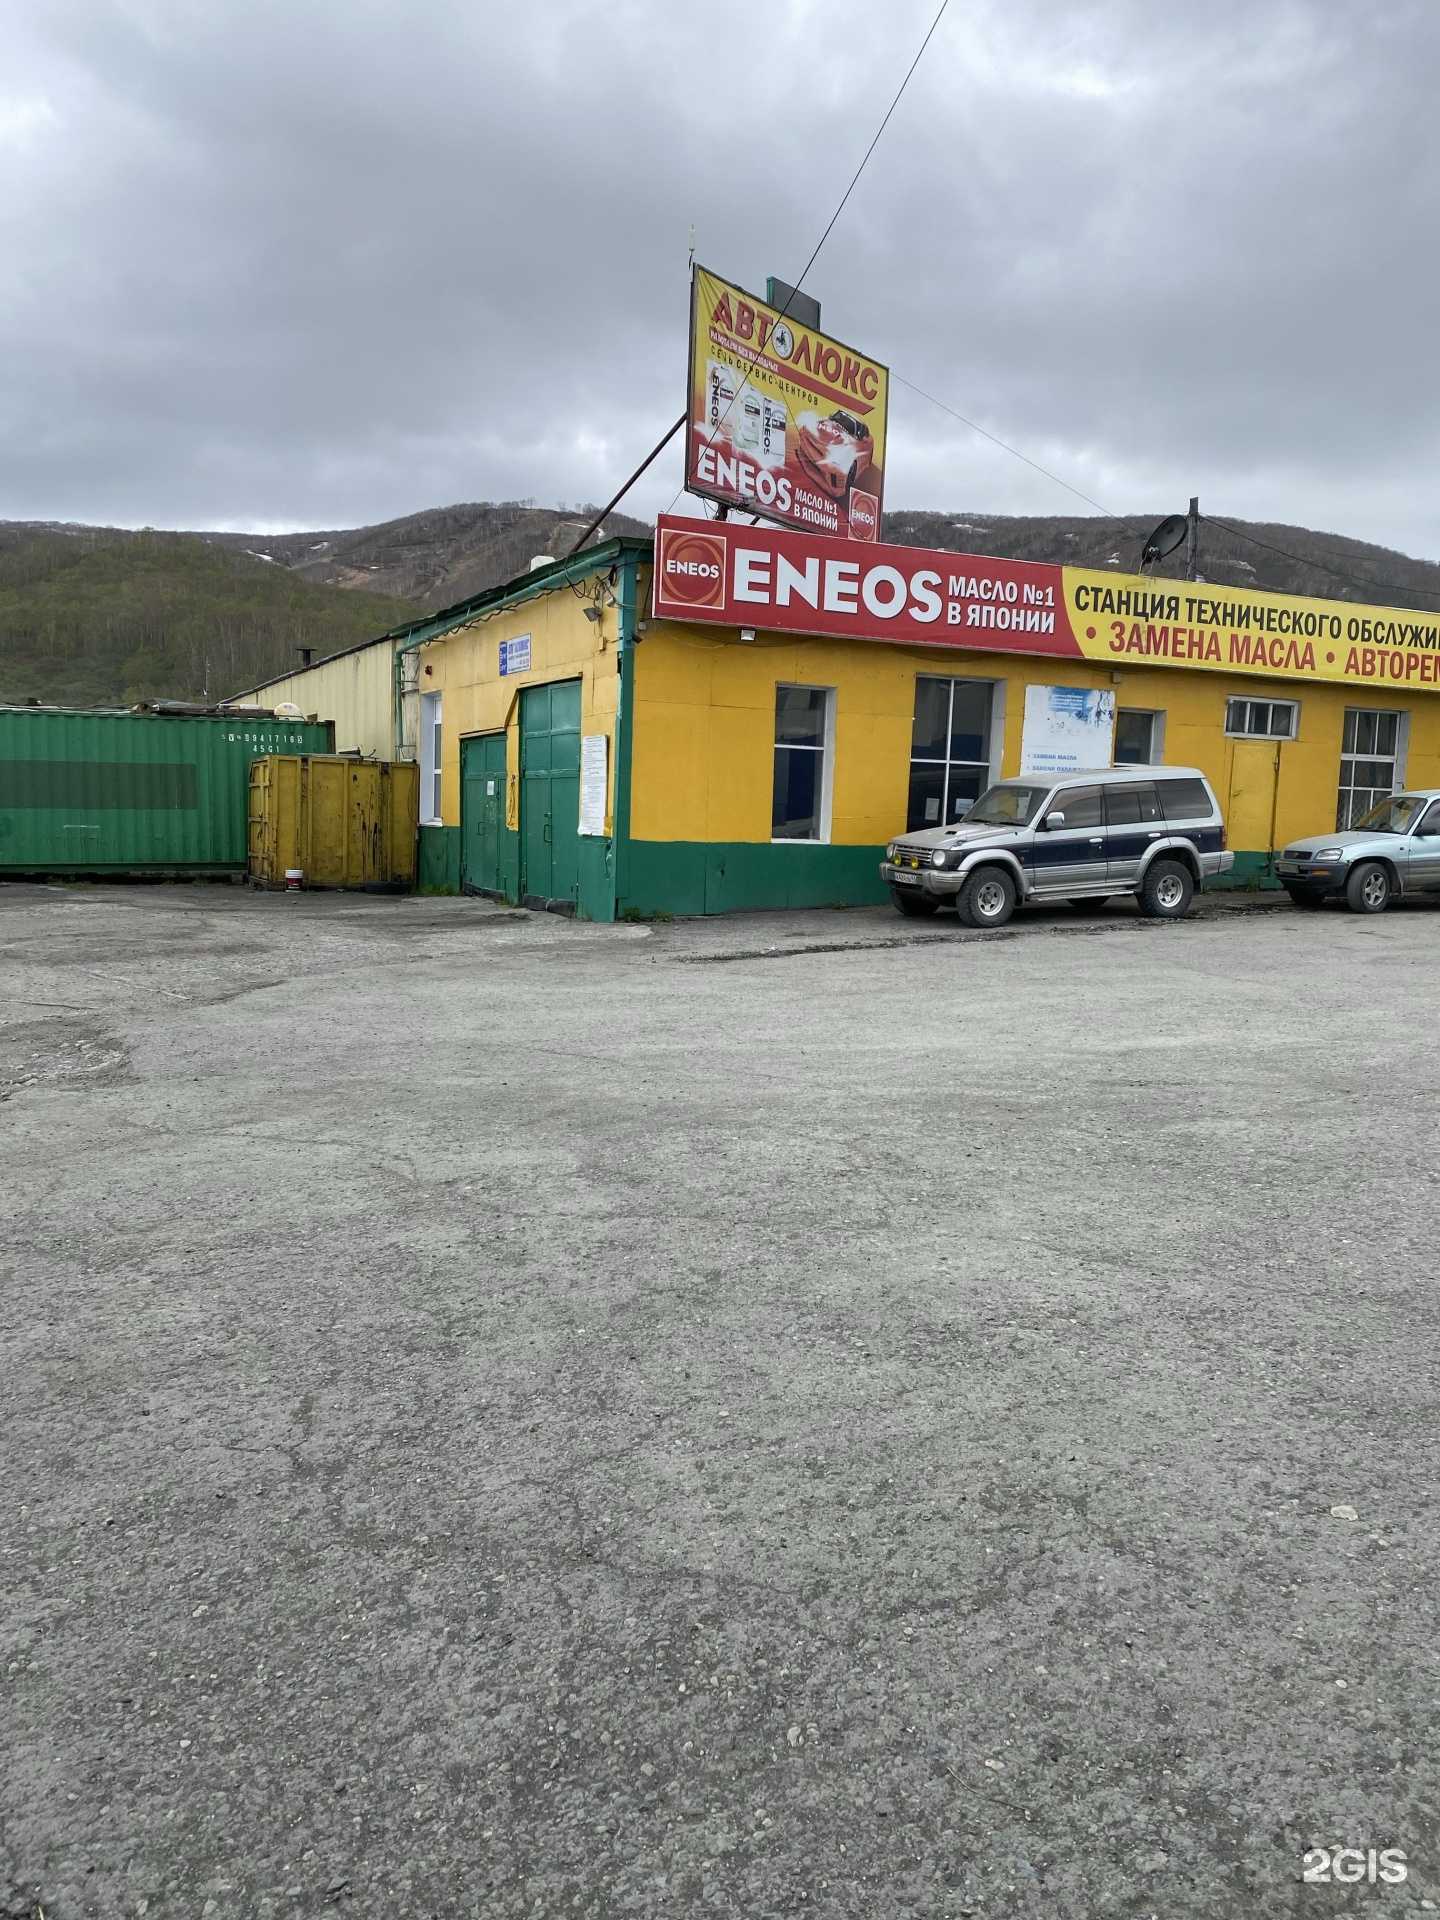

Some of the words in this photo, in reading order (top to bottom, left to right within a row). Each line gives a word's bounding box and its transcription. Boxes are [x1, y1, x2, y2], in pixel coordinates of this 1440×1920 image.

[764, 406, 772, 455] ENEOS
[697, 444, 792, 512] ENEOS
[795, 487, 824, 510] МАСЛО
[824, 500, 838, 515] №1
[851, 508, 875, 525] ENEOS
[794, 504, 801, 517] В
[802, 507, 838, 532] ЯПОНИИ
[666, 559, 720, 579] ENEOS
[733, 548, 943, 624] ENEOS
[948, 575, 1018, 607] МАСЛО
[1023, 585, 1055, 608] №1
[947, 603, 962, 625] В
[966, 605, 1055, 634] ЯПОНИИ
[1074, 584, 1180, 622] СТАНЦИЯ
[1185, 597, 1342, 640] ТЕХНИЧЕСКОГО
[1347, 617, 1440, 650] ОБСЛУЖИ
[1109, 620, 1222, 662] ЗАМЕНА
[1229, 633, 1316, 671] МАСЛА
